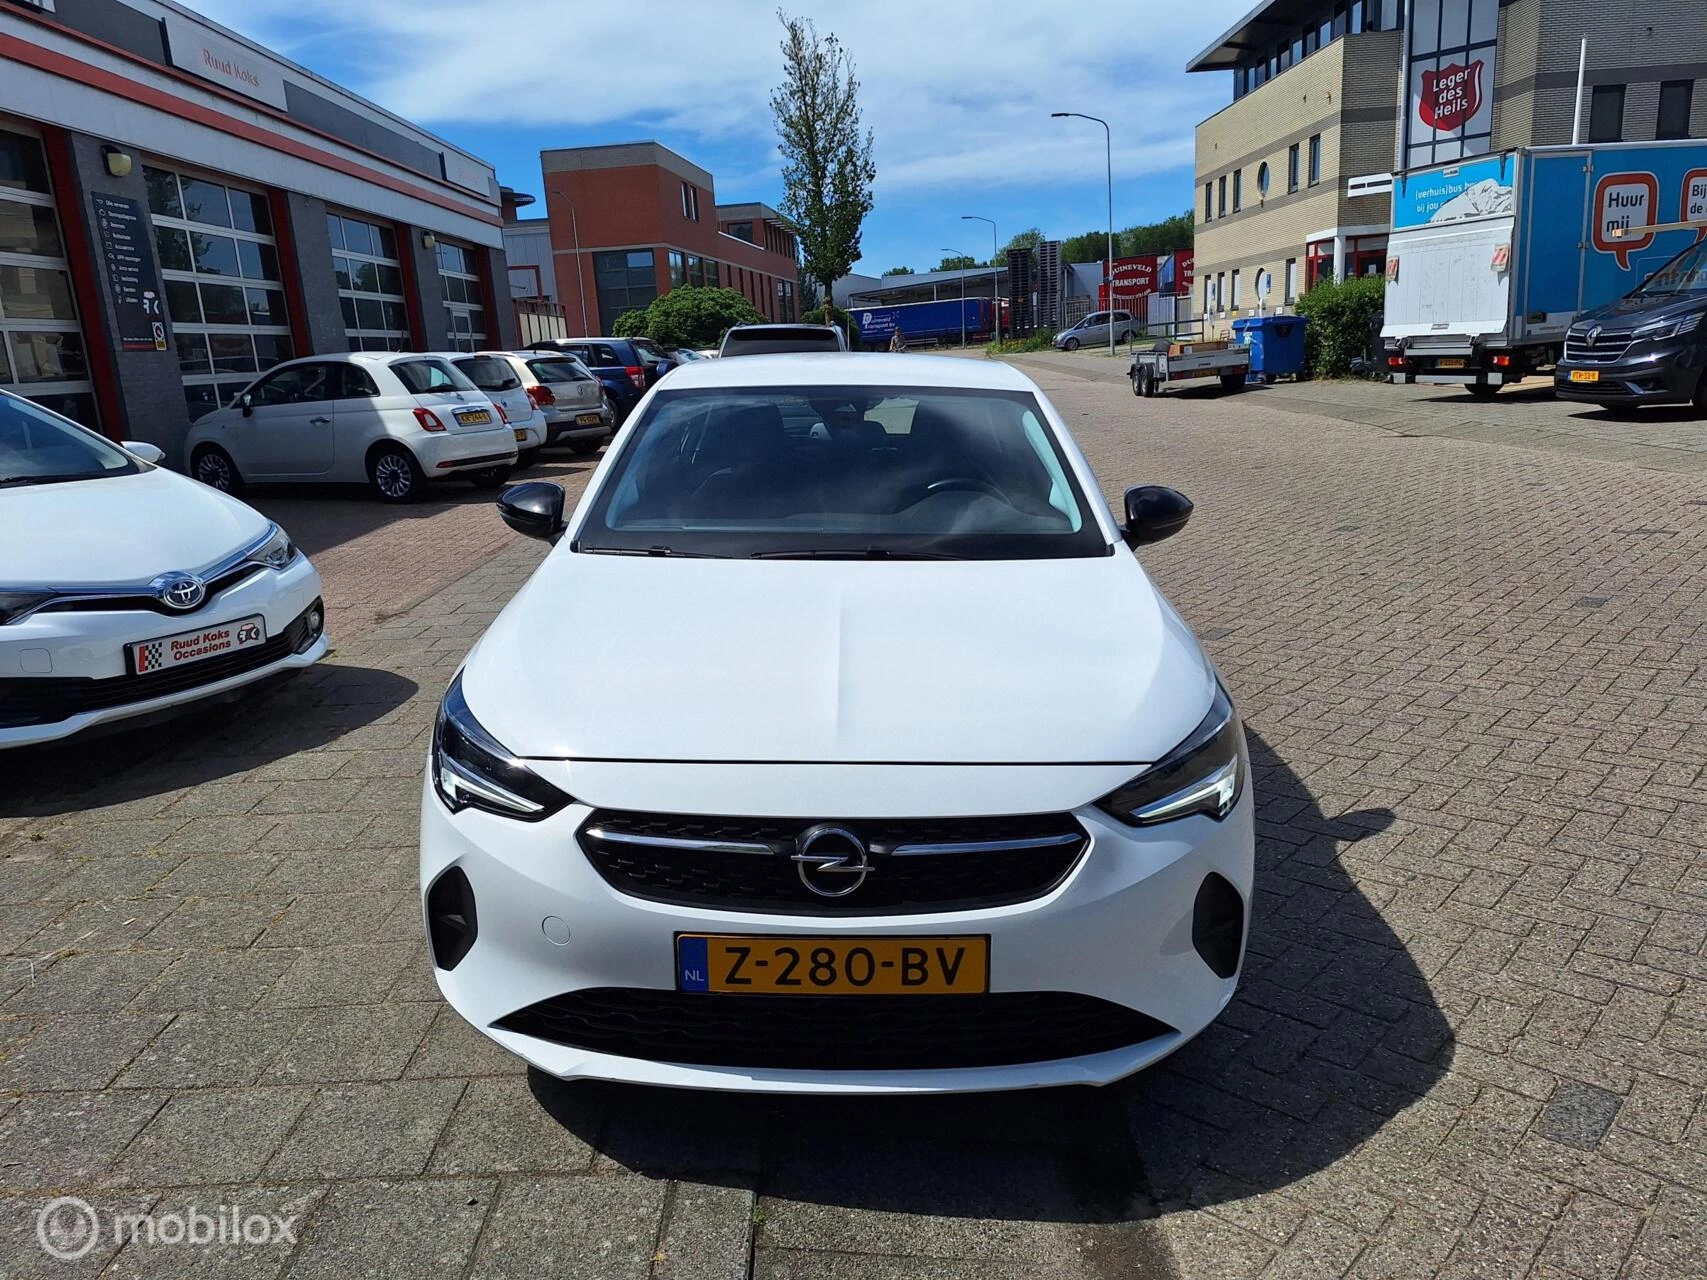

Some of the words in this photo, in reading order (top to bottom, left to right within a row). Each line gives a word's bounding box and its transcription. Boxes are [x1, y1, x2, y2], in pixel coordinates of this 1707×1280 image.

[203, 48, 232, 75] Ruud
[234, 63, 260, 87] Koks
[1433, 68, 1471, 92] Leger
[1438, 86, 1464, 104] des
[1434, 97, 1469, 119] Heils
[1415, 184, 1462, 201] (verhuis)bus
[1608, 191, 1645, 209] Huur
[1692, 184, 1707, 200] Bij
[1416, 204, 1425, 213] bij
[1426, 202, 1439, 213] jou
[1690, 203, 1703, 214] de
[1112, 277, 1150, 288] TRANSPORT
[170, 635, 200, 652] Ruud
[202, 630, 230, 644] Koks
[173, 640, 232, 661] Occasions
[684, 969, 705, 982] NL
[724, 946, 966, 987] Z-280-BV
